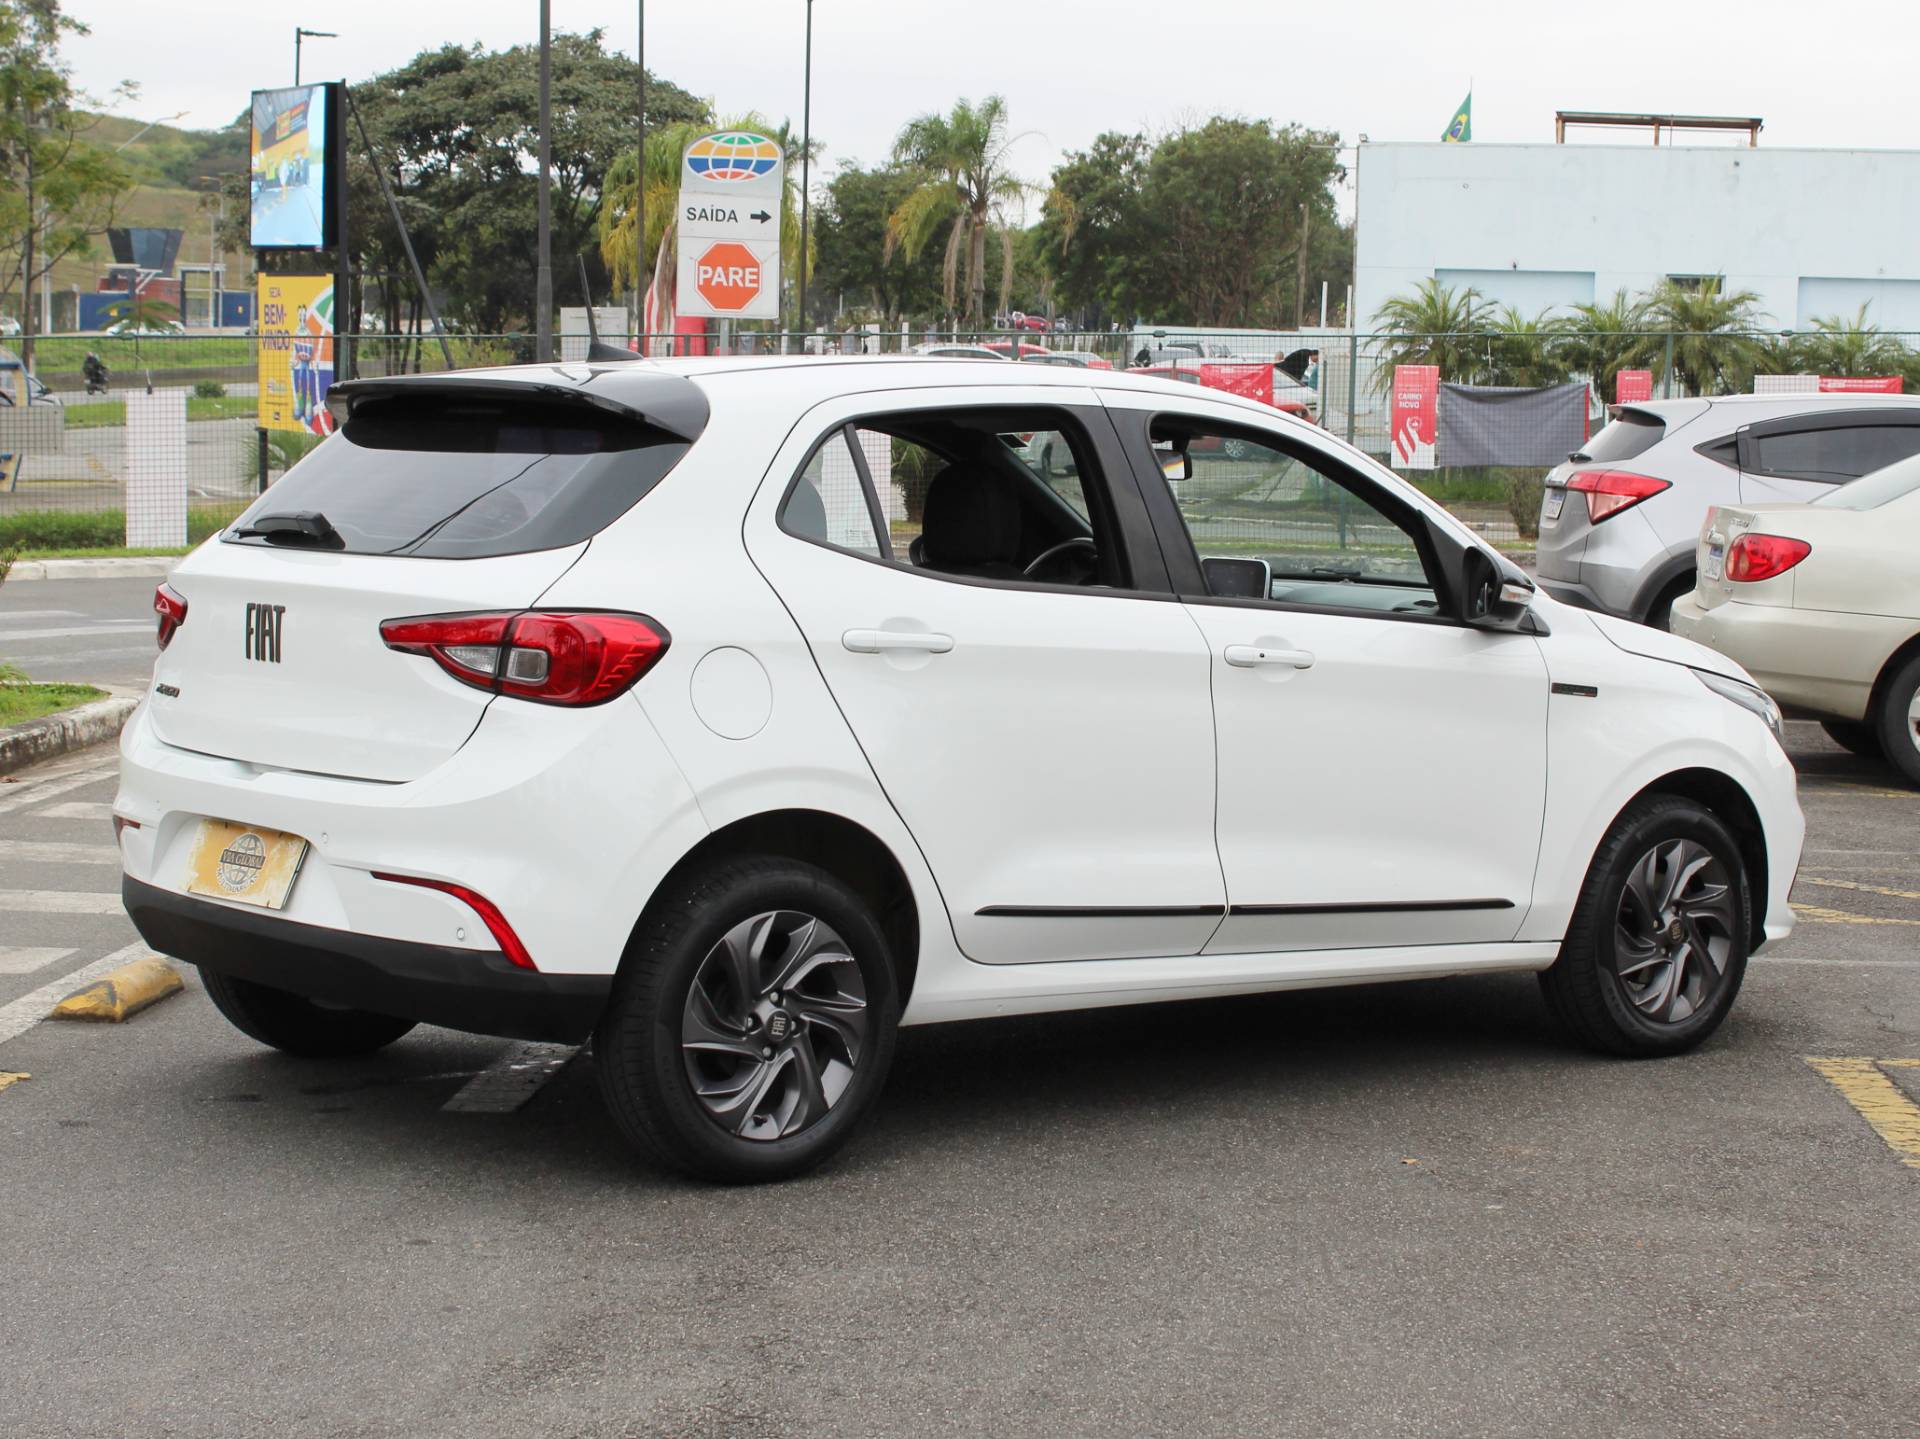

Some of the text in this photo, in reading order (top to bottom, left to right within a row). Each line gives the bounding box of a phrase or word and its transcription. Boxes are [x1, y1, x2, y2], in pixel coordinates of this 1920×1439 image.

[686, 204, 738, 223] SAÍDA
[698, 265, 759, 288] PARE
[264, 304, 287, 325] BEM-
[261, 329, 290, 350] VINDO
[245, 602, 286, 664] FIAT
[222, 850, 263, 869] VIA GLOBAL
[770, 1014, 786, 1036] FIAT
